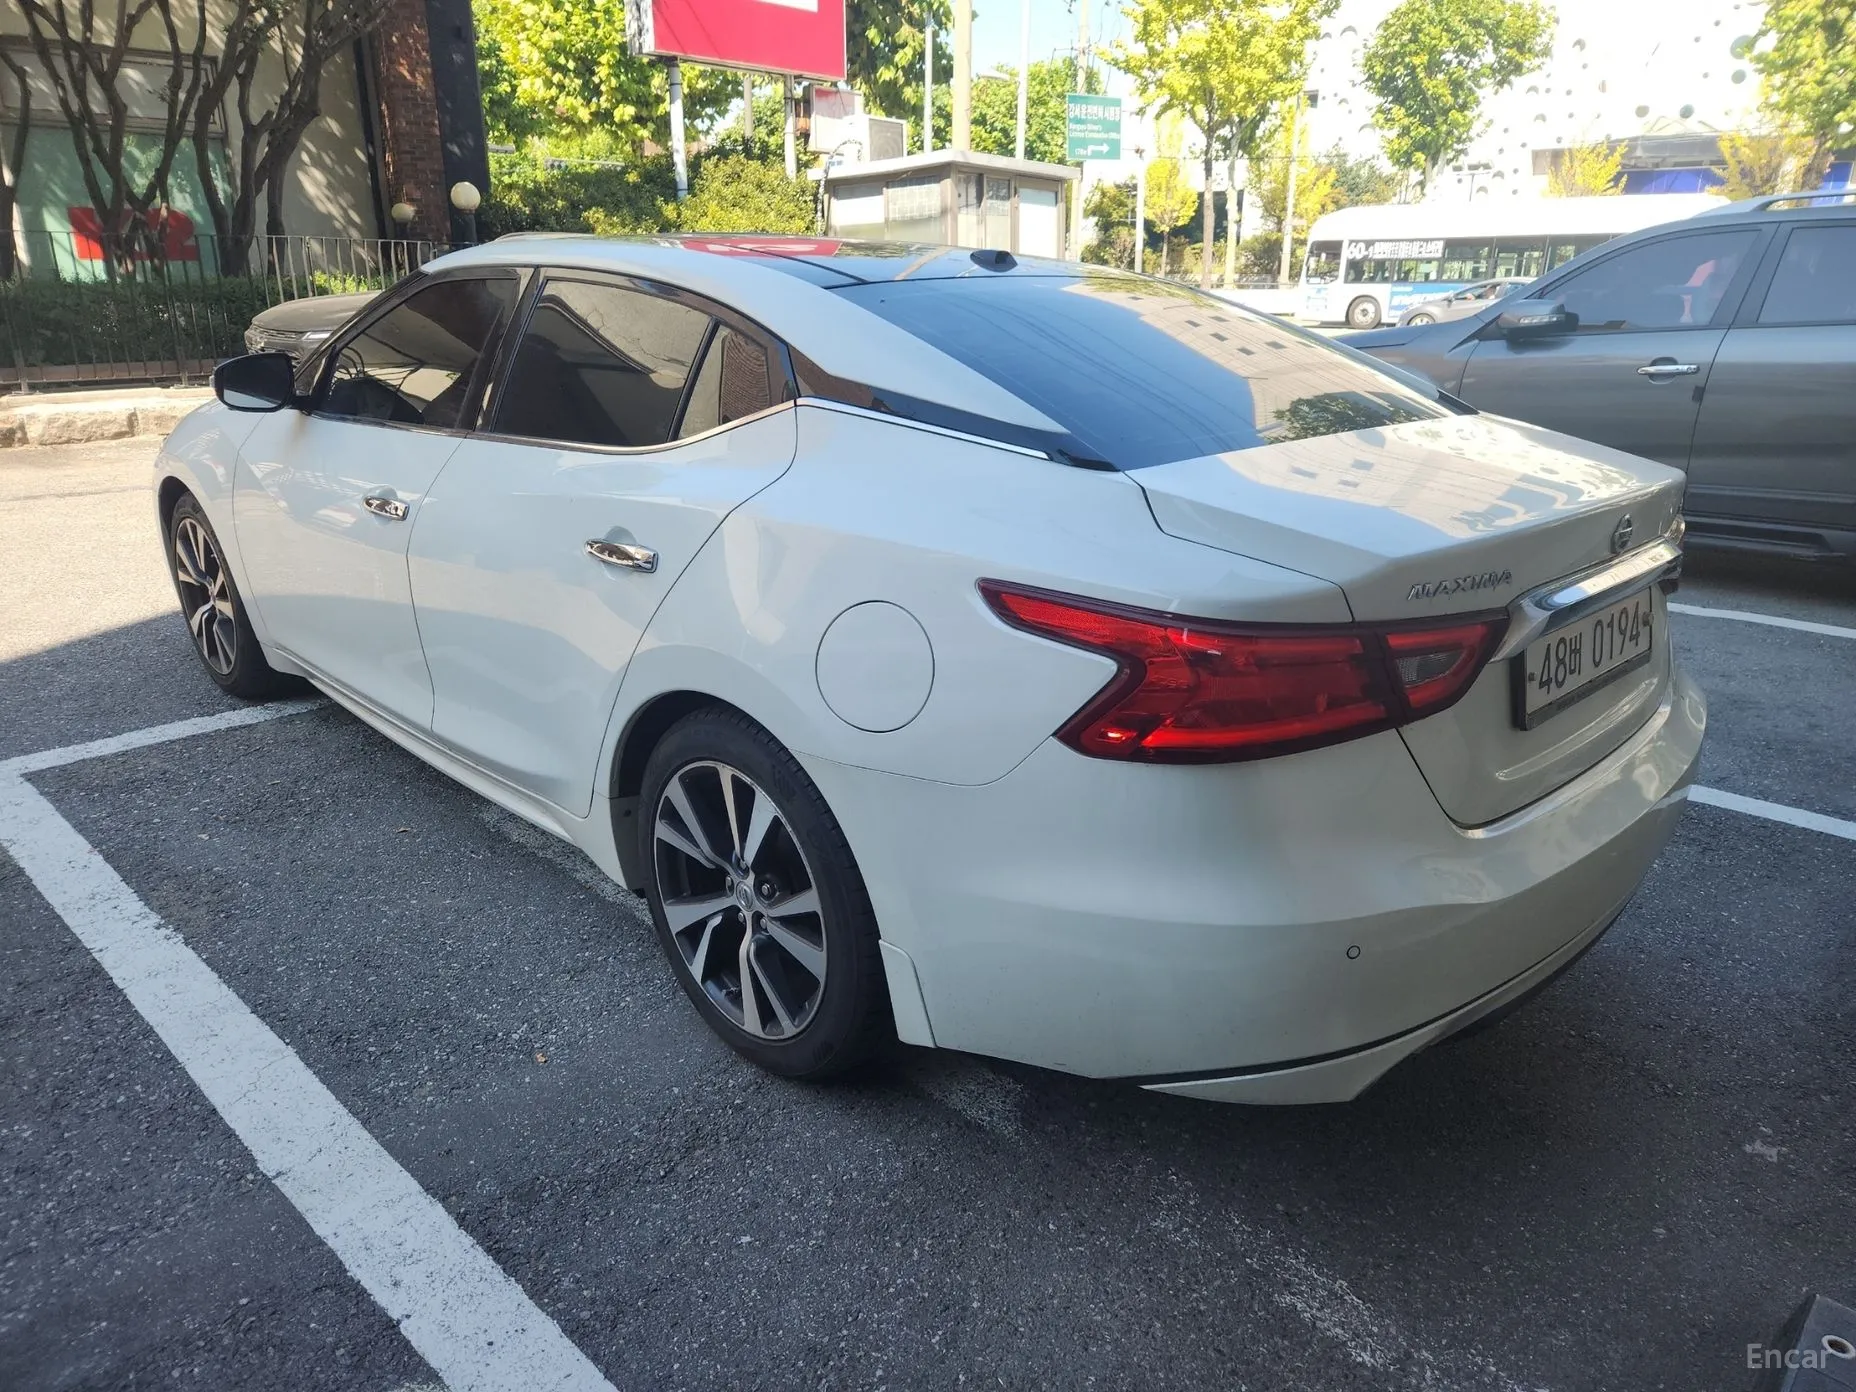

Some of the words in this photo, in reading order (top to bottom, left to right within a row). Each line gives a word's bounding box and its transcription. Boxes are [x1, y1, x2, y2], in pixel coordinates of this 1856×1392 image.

[1407, 569, 1512, 600] MAXIMA
[1538, 632, 1582, 695] 48버
[1592, 600, 1642, 669] 0194
